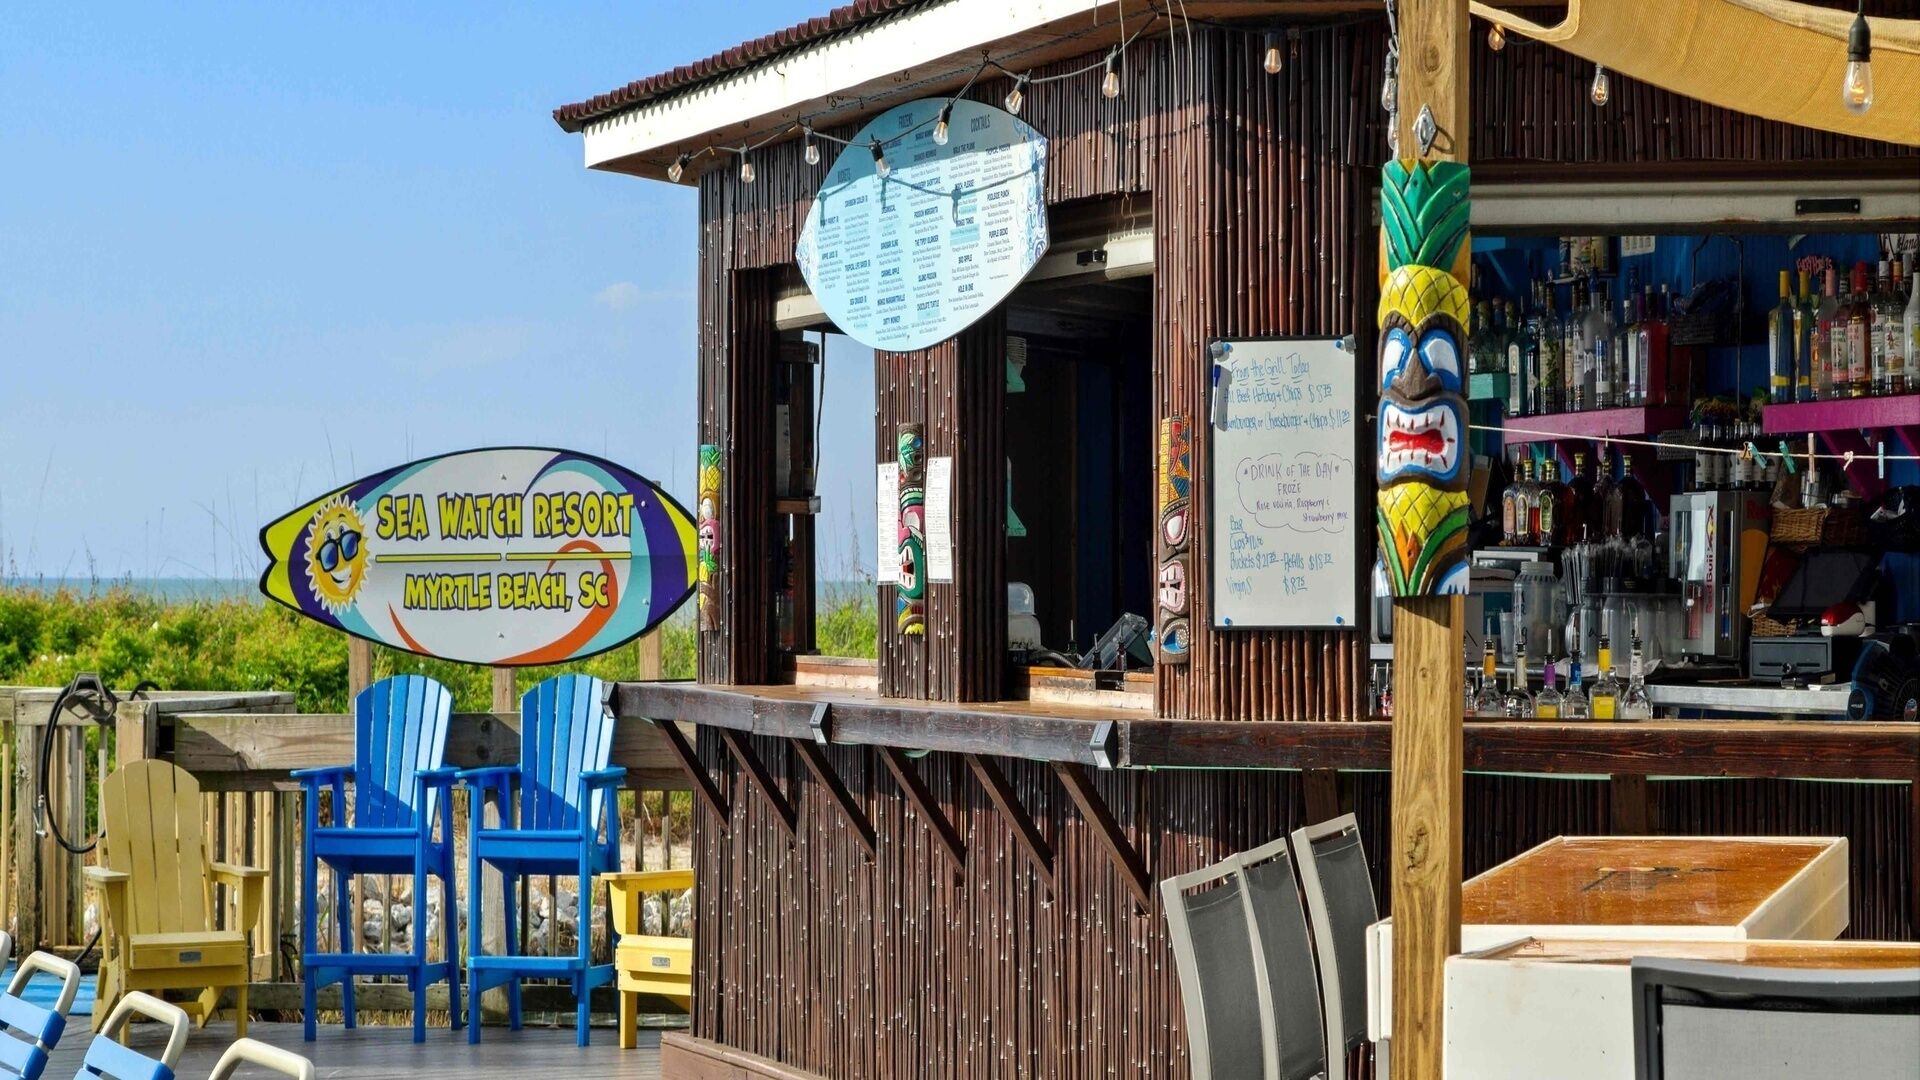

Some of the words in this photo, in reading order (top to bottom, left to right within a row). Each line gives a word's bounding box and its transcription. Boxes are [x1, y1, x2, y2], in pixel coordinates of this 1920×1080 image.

[971, 114, 990, 132] COCKTAILS
[1232, 360, 1249, 378] From
[1251, 358, 1264, 377] the
[1265, 356, 1287, 376] Grill
[1287, 352, 1310, 378] Today
[1251, 463, 1282, 480] DRINK
[1286, 465, 1295, 476] OF
[1298, 463, 1310, 476] THE
[1316, 460, 1333, 480] DAY
[376, 494, 429, 541] SEA
[438, 492, 525, 539] WATCH
[533, 492, 634, 538] RESORT
[404, 572, 491, 610] MYRTLE
[498, 572, 572, 613] BEACH,
[578, 572, 609, 608] SC
